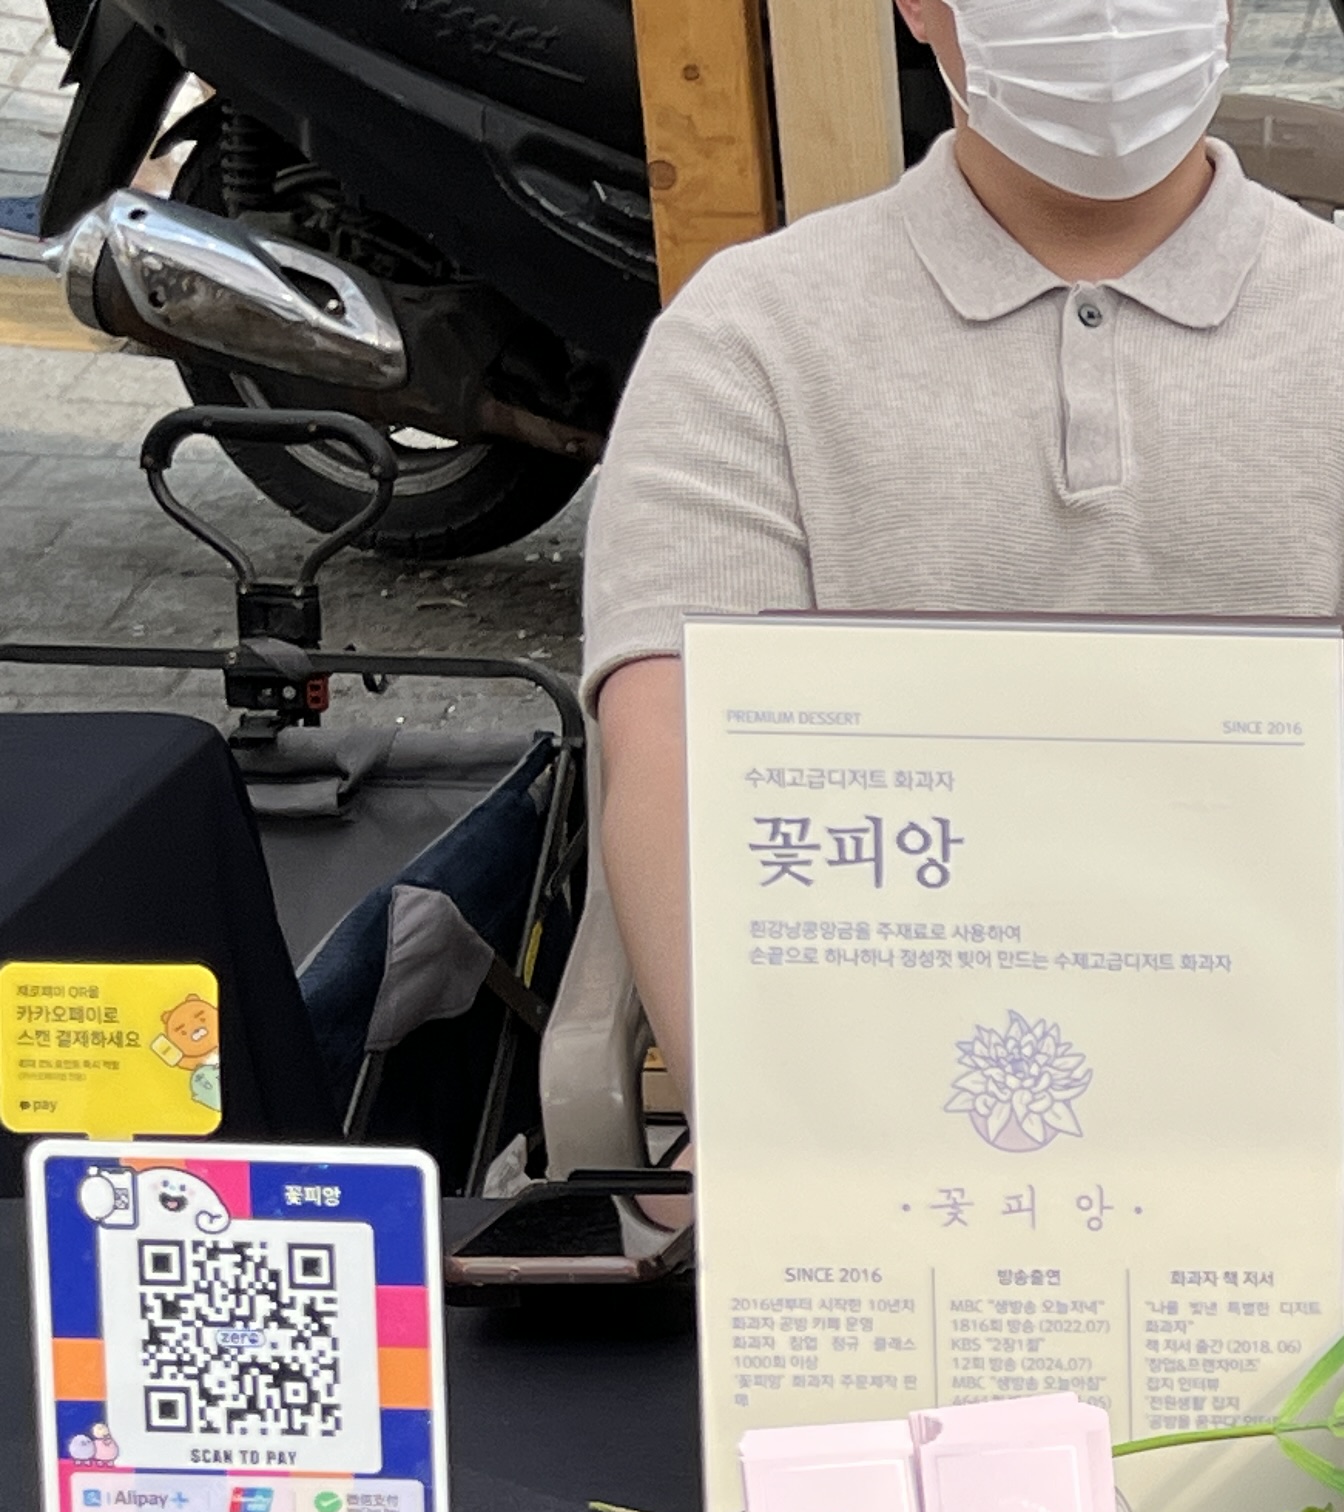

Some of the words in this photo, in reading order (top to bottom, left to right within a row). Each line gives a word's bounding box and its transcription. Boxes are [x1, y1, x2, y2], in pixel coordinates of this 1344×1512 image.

[726, 710, 794, 725] PREMIUM
[797, 711, 861, 726] DESSERT
[1222, 720, 1264, 736] SINCE
[1267, 721, 1302, 736] 2016
[744, 767, 888, 791] 수제고급디저트
[893, 769, 954, 792] 화과자
[748, 812, 964, 889] 꽃피앙
[876, 921, 947, 942] 주재료로
[952, 922, 1021, 943] 사용하여
[749, 946, 819, 966] 손끝으로
[824, 946, 895, 967] 하나하나
[900, 948, 952, 968] 정성껏
[996, 951, 1050, 970] 만드는
[1054, 951, 1176, 972] 수제고급디저트
[1180, 953, 1232, 973] 화과자
[16, 1005, 120, 1025] 카카오페이로
[17, 1030, 52, 1049] 스캔
[55, 1030, 141, 1049] 결제하세요
[33, 1098, 58, 1113] pay
[285, 1185, 342, 1207] 꽃피앙
[785, 1268, 834, 1283] SINCE
[839, 1268, 883, 1283] 2016
[997, 1269, 1061, 1286] 방송출연
[1170, 1270, 1218, 1287] 화과자
[1243, 1271, 1274, 1287] 저서
[951, 1337, 982, 1352] KBS
[191, 1449, 232, 1464] SCAN
[240, 1450, 259, 1465] TO
[267, 1451, 297, 1466] PAY
